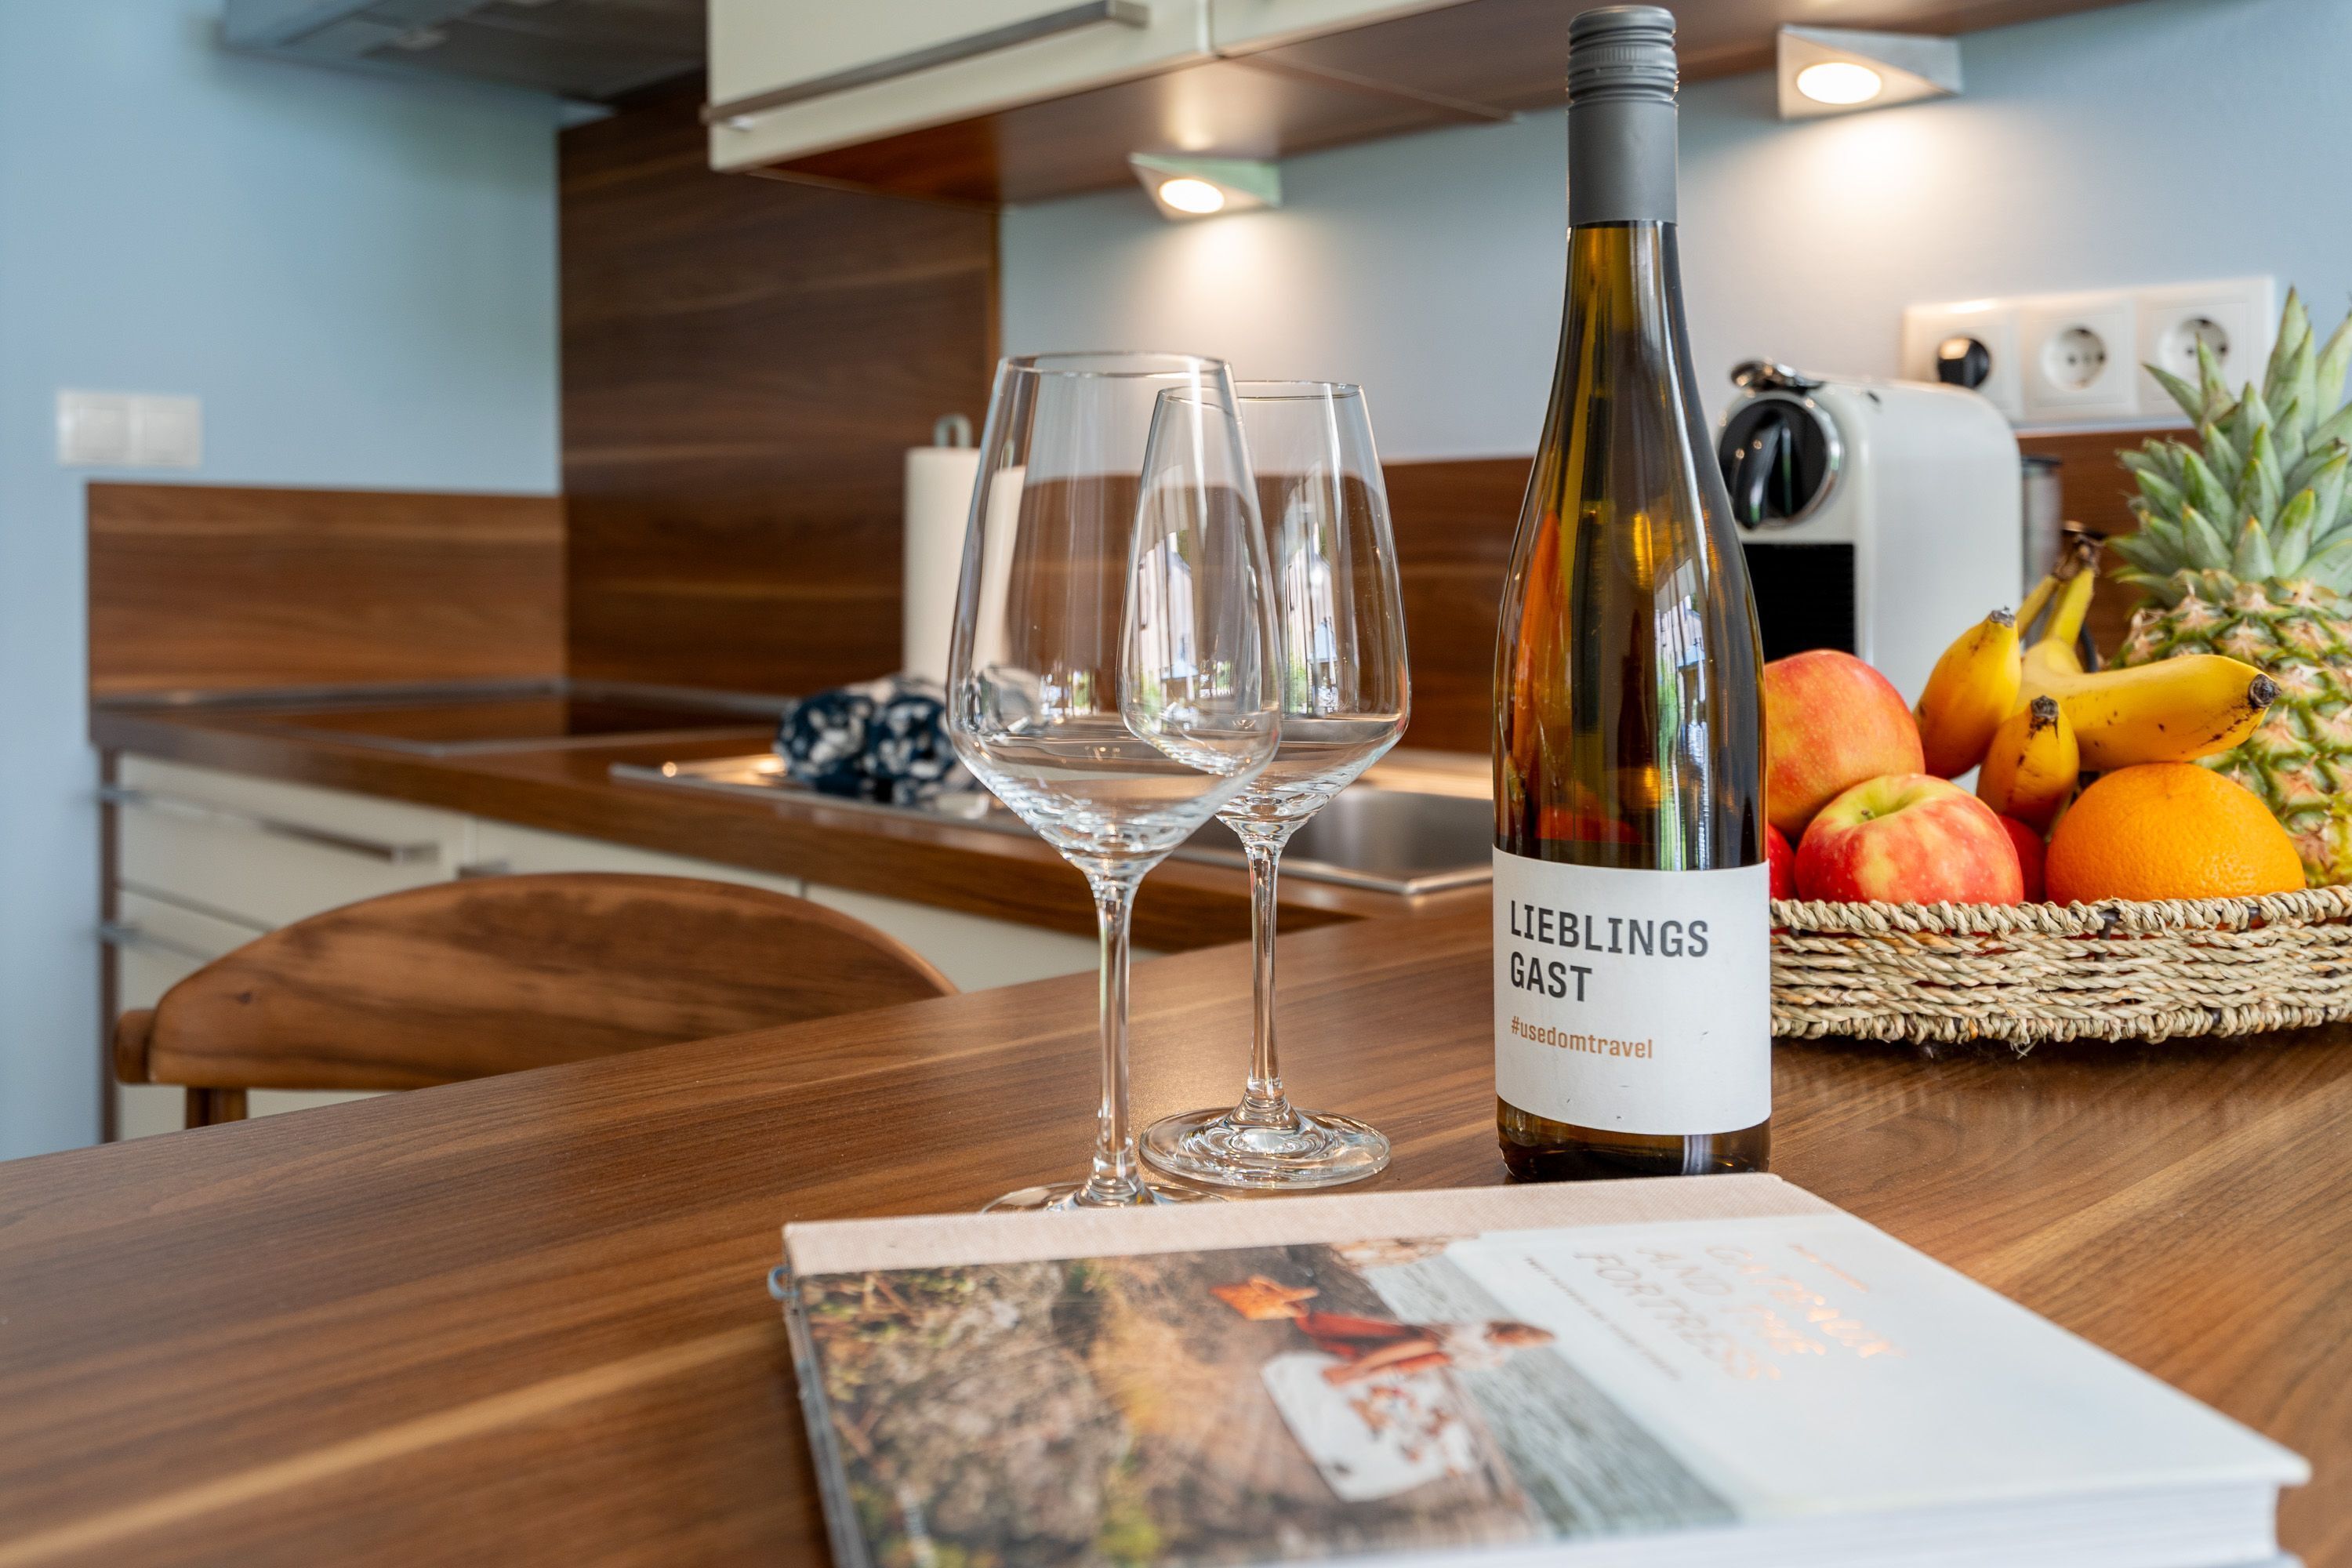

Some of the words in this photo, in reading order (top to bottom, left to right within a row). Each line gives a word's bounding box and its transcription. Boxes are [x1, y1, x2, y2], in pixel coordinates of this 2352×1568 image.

[1511, 899, 1709, 957] LIEBLINGS
[1511, 951, 1593, 1002] GAST
[1511, 1015, 1653, 1059] #usedomtravel
